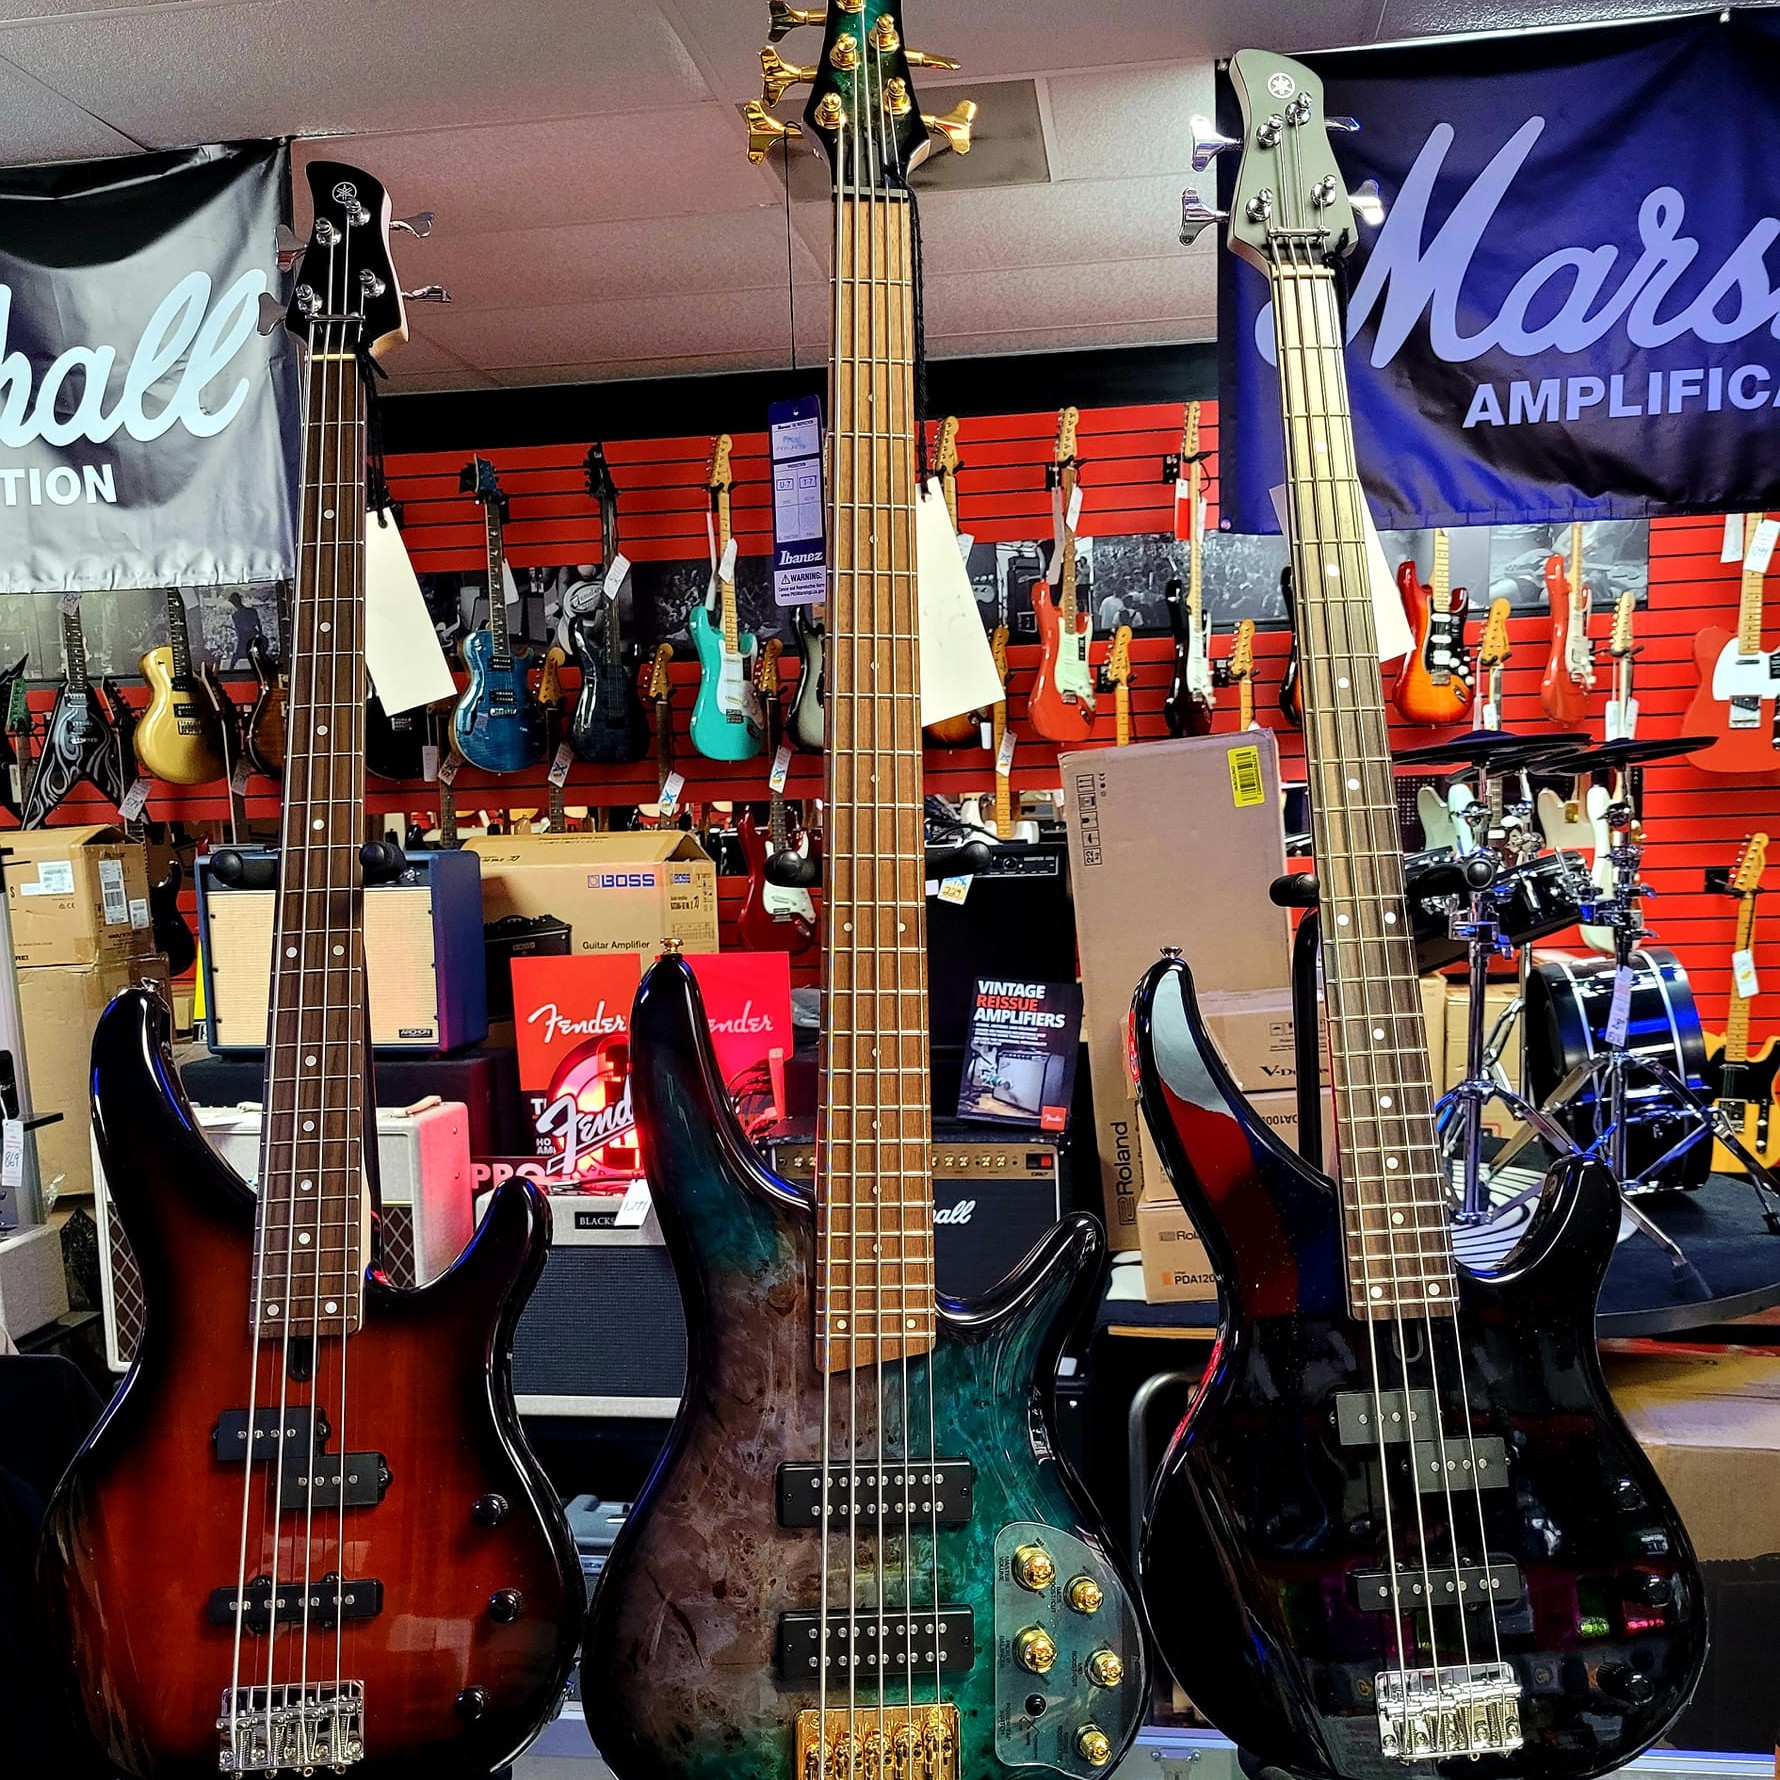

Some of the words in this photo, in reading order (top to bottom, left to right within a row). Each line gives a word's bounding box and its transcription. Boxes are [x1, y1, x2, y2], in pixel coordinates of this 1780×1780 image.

[0, 463, 118, 506] TION
[778, 550, 823, 566] Ibanez
[601, 874, 655, 888] BOSS
[582, 940, 608, 950] Guitar
[611, 939, 651, 953] Amplifier
[978, 980, 1046, 999] VINTAGE
[976, 994, 1038, 1011] REISSUE
[527, 1000, 627, 1044] Fender
[707, 1000, 774, 1034] ender
[973, 1007, 1066, 1028] AMPLIFIERS
[1110, 1121, 1135, 1196] Roland
[579, 1216, 617, 1226] BLACKS
